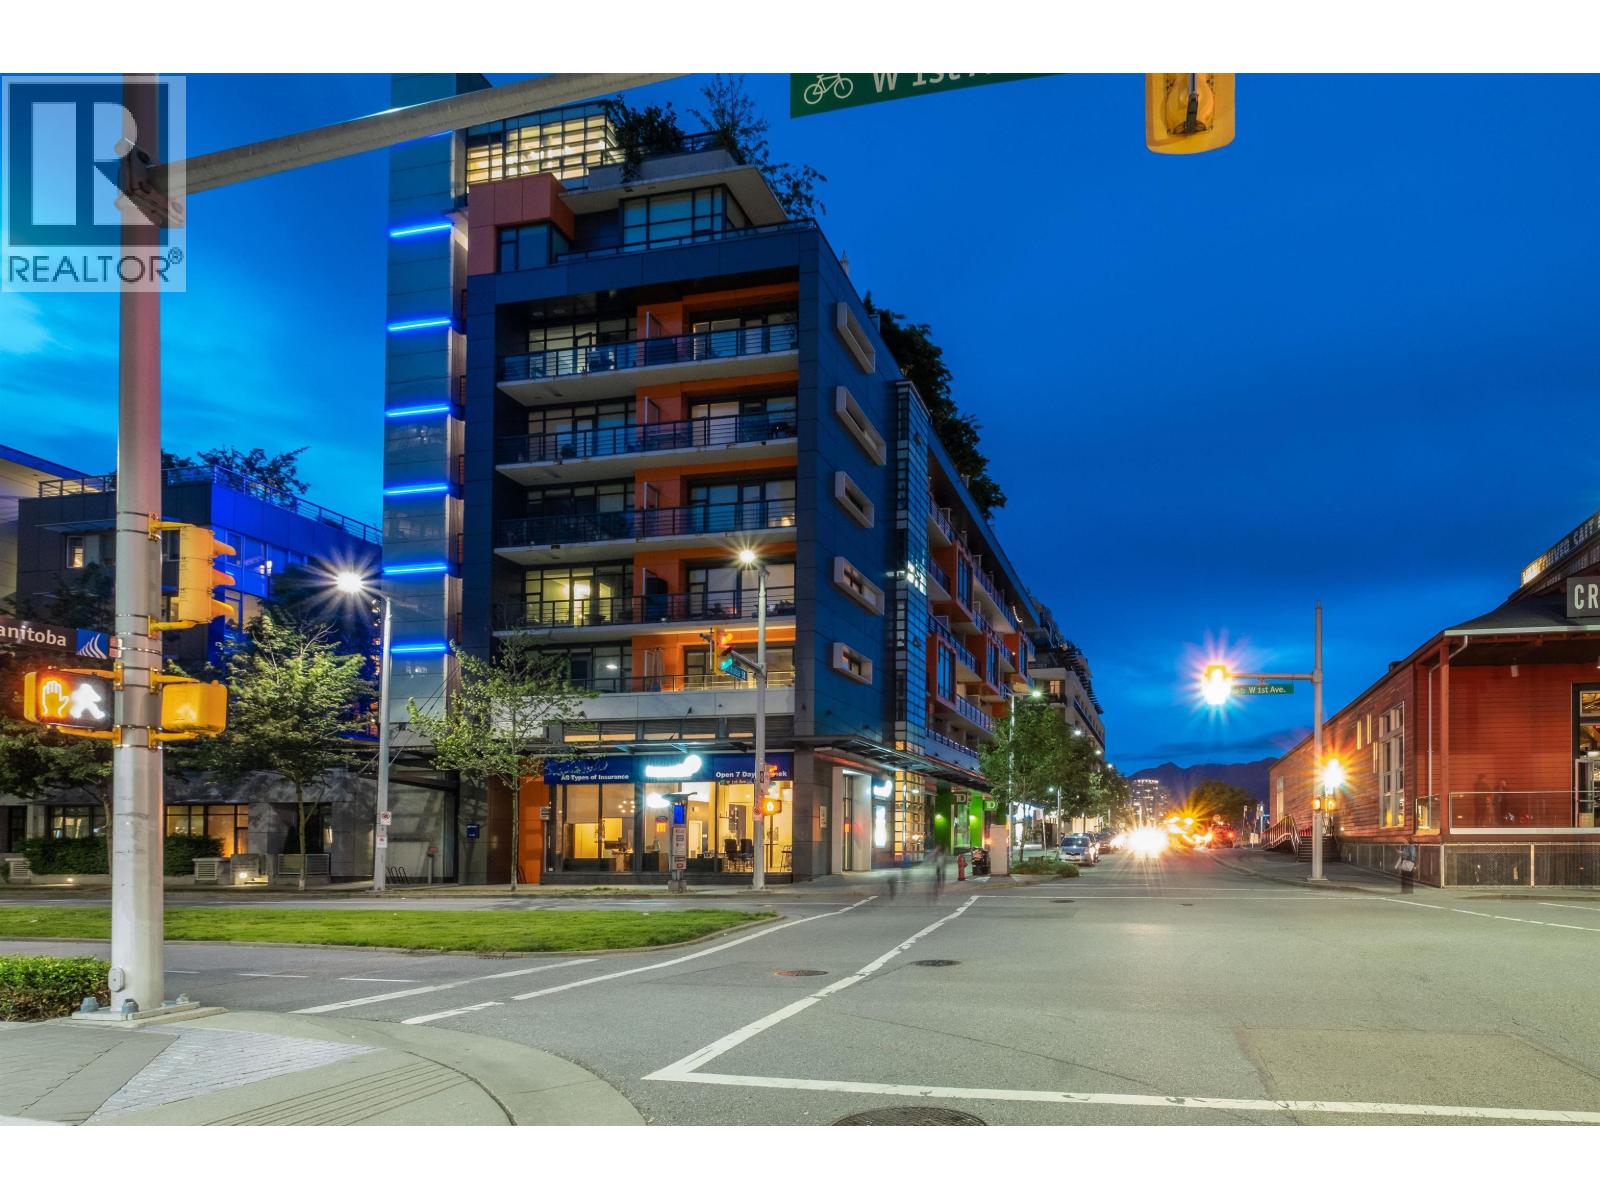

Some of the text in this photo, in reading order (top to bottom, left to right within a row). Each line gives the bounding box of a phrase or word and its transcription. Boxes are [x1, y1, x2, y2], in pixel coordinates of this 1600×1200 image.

[873, 72, 898, 93] W
[1248, 686, 1256, 694] W
[1257, 686, 1269, 694] 1st
[715, 771, 734, 779] Open
[742, 771, 756, 779] Day
[953, 794, 966, 802] TD
[986, 801, 996, 809] TD
